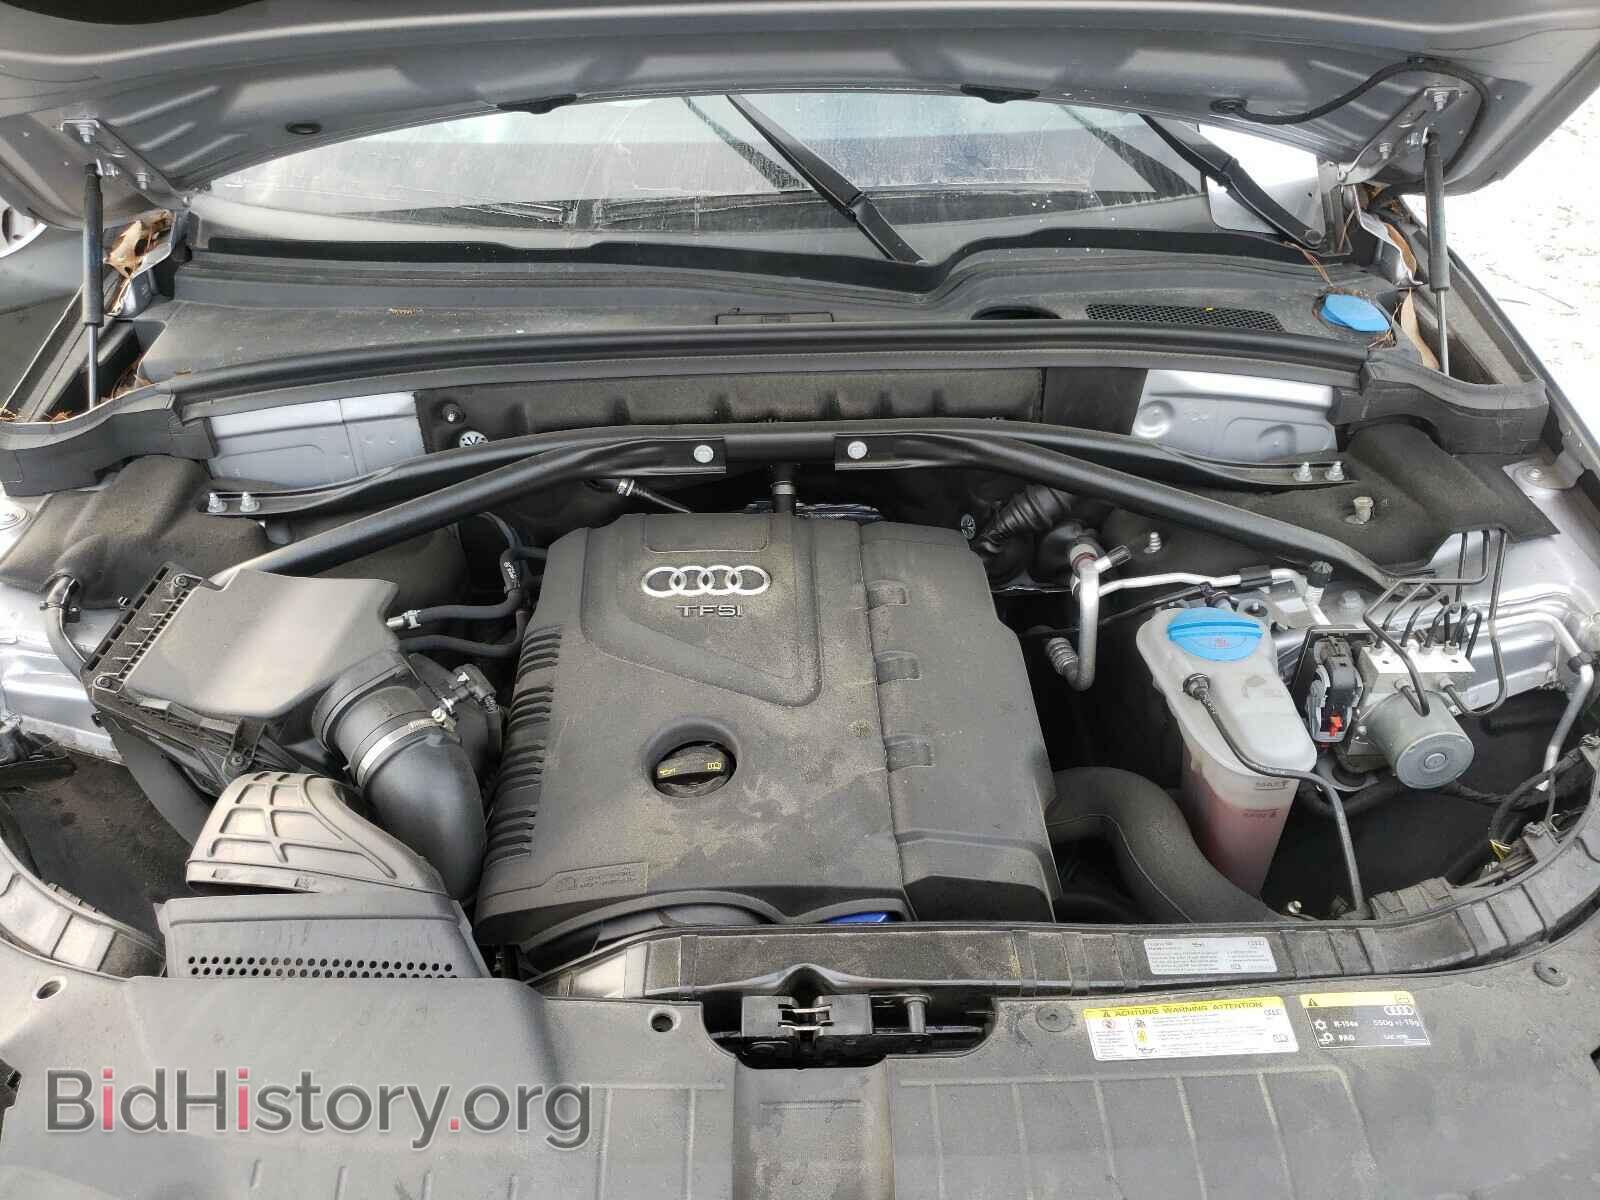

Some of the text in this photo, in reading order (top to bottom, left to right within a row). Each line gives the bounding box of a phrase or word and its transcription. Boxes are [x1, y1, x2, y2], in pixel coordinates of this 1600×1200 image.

[676, 604, 742, 617] TFSI
[1115, 1001, 1263, 1017] ACHTUNG WARNING ATTENTION
